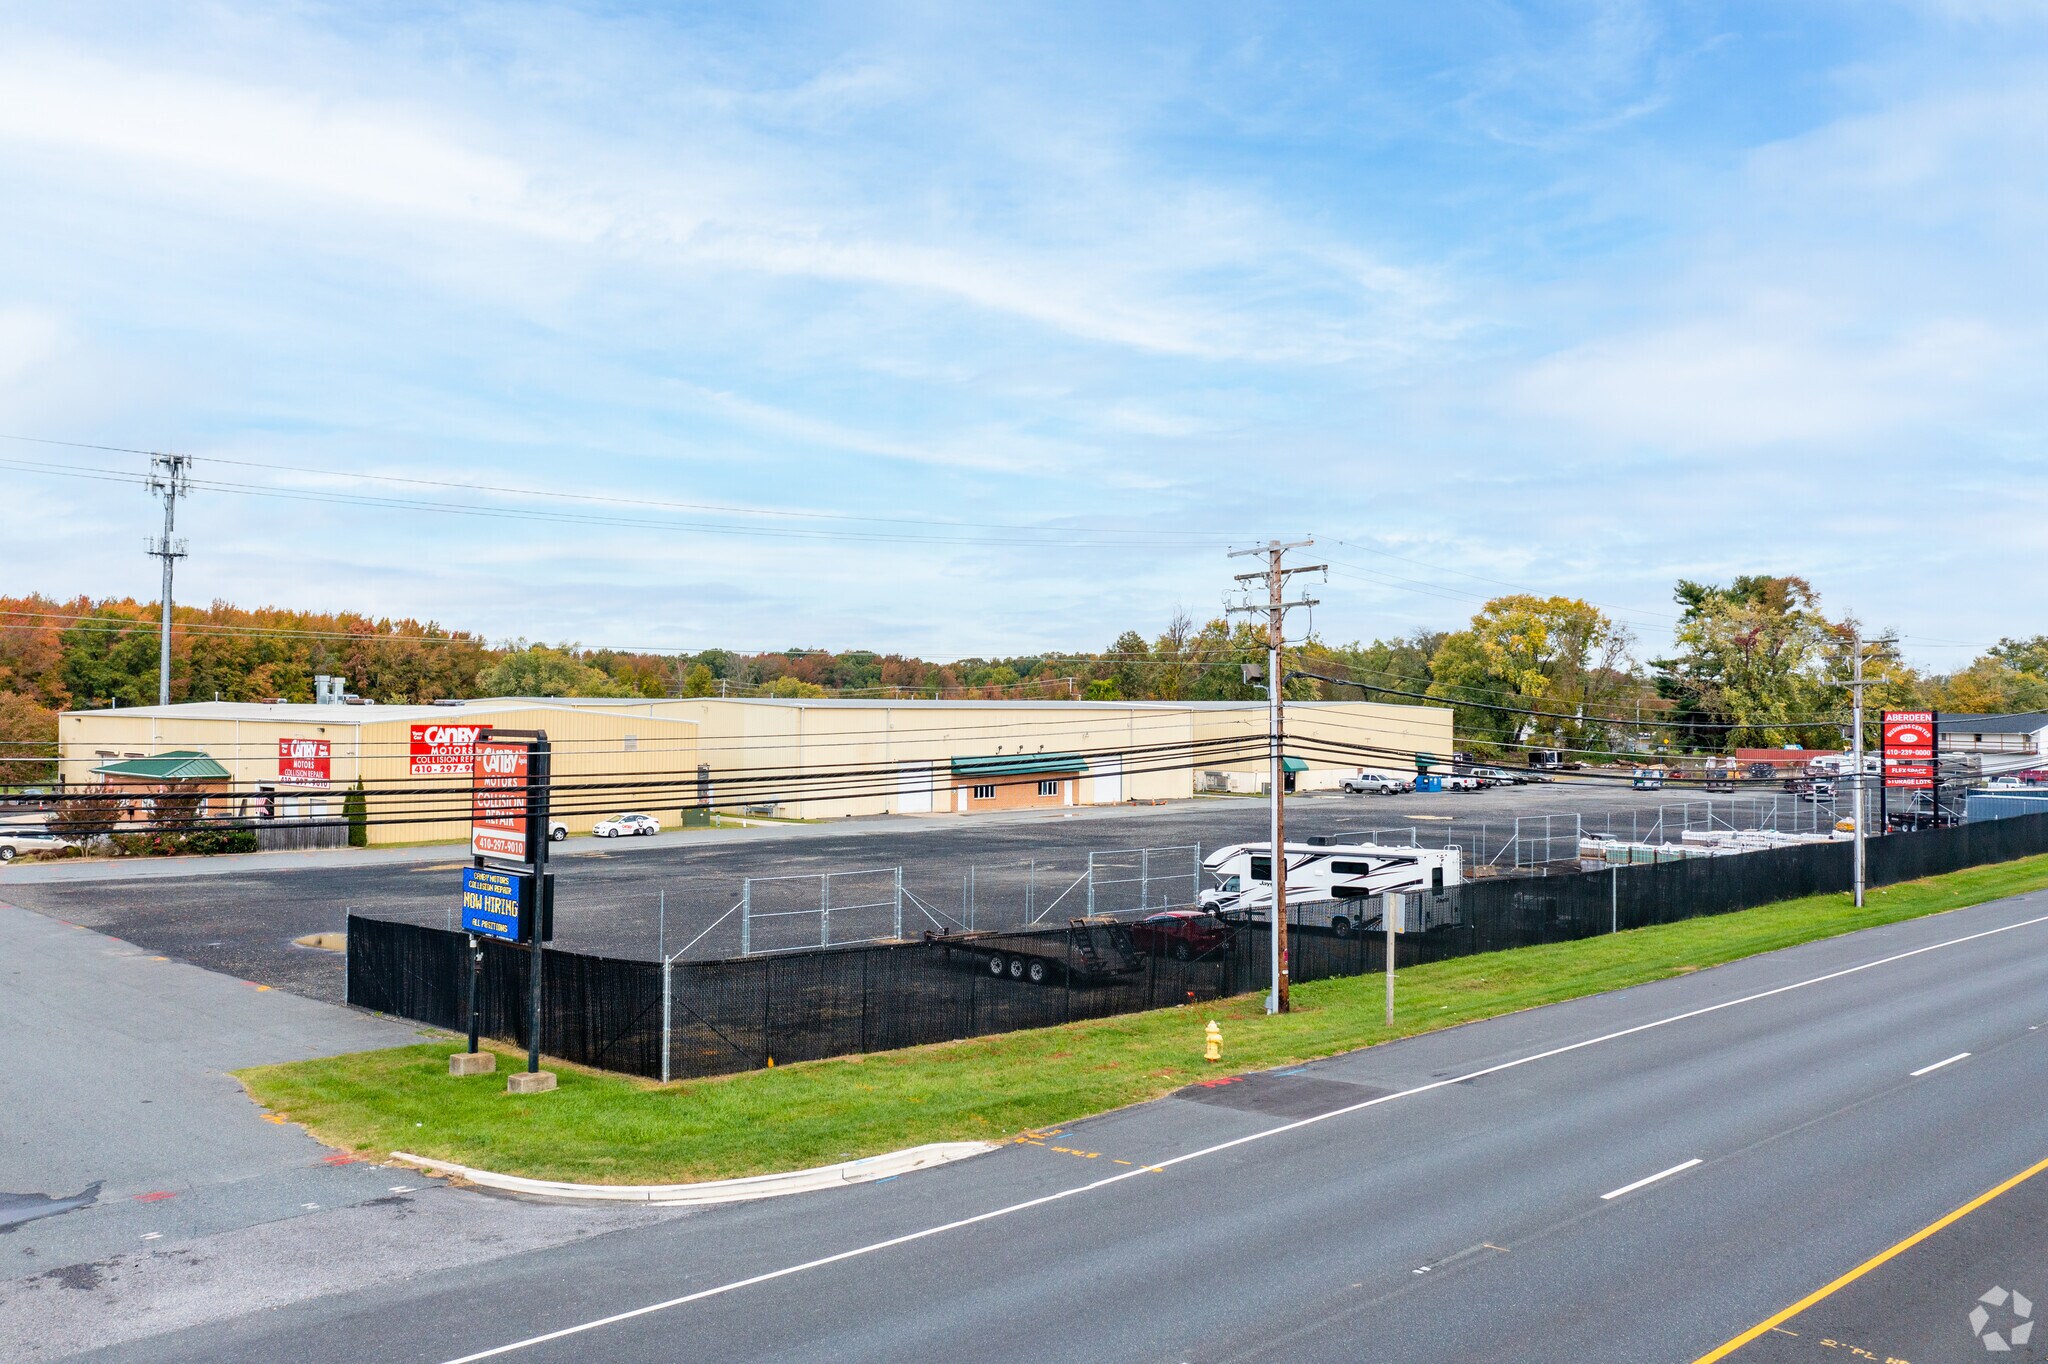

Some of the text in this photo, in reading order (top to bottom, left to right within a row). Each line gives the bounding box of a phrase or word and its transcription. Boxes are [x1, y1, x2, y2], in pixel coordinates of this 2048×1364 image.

[1886, 713, 1932, 721] ABERDEEN
[1886, 724, 1931, 738] BUSINESS CENTER
[431, 746, 474, 755] MOTORS
[293, 759, 315, 769] MOTORS
[416, 756, 459, 764] COLLISION
[284, 768, 324, 779] COLLISION REPAIR
[415, 765, 474, 773] 410-297-9
[484, 775, 518, 788] MOTORS
[477, 792, 525, 810] COLLISION
[485, 809, 515, 827] REPAIR
[479, 837, 523, 854] 410-297-9010
[474, 872, 510, 885] CANBY MOTORS
[469, 881, 512, 895] COLLISION REPAIR
[463, 892, 519, 917] NOW HIRING
[472, 918, 508, 932] ALL POSITIONS
